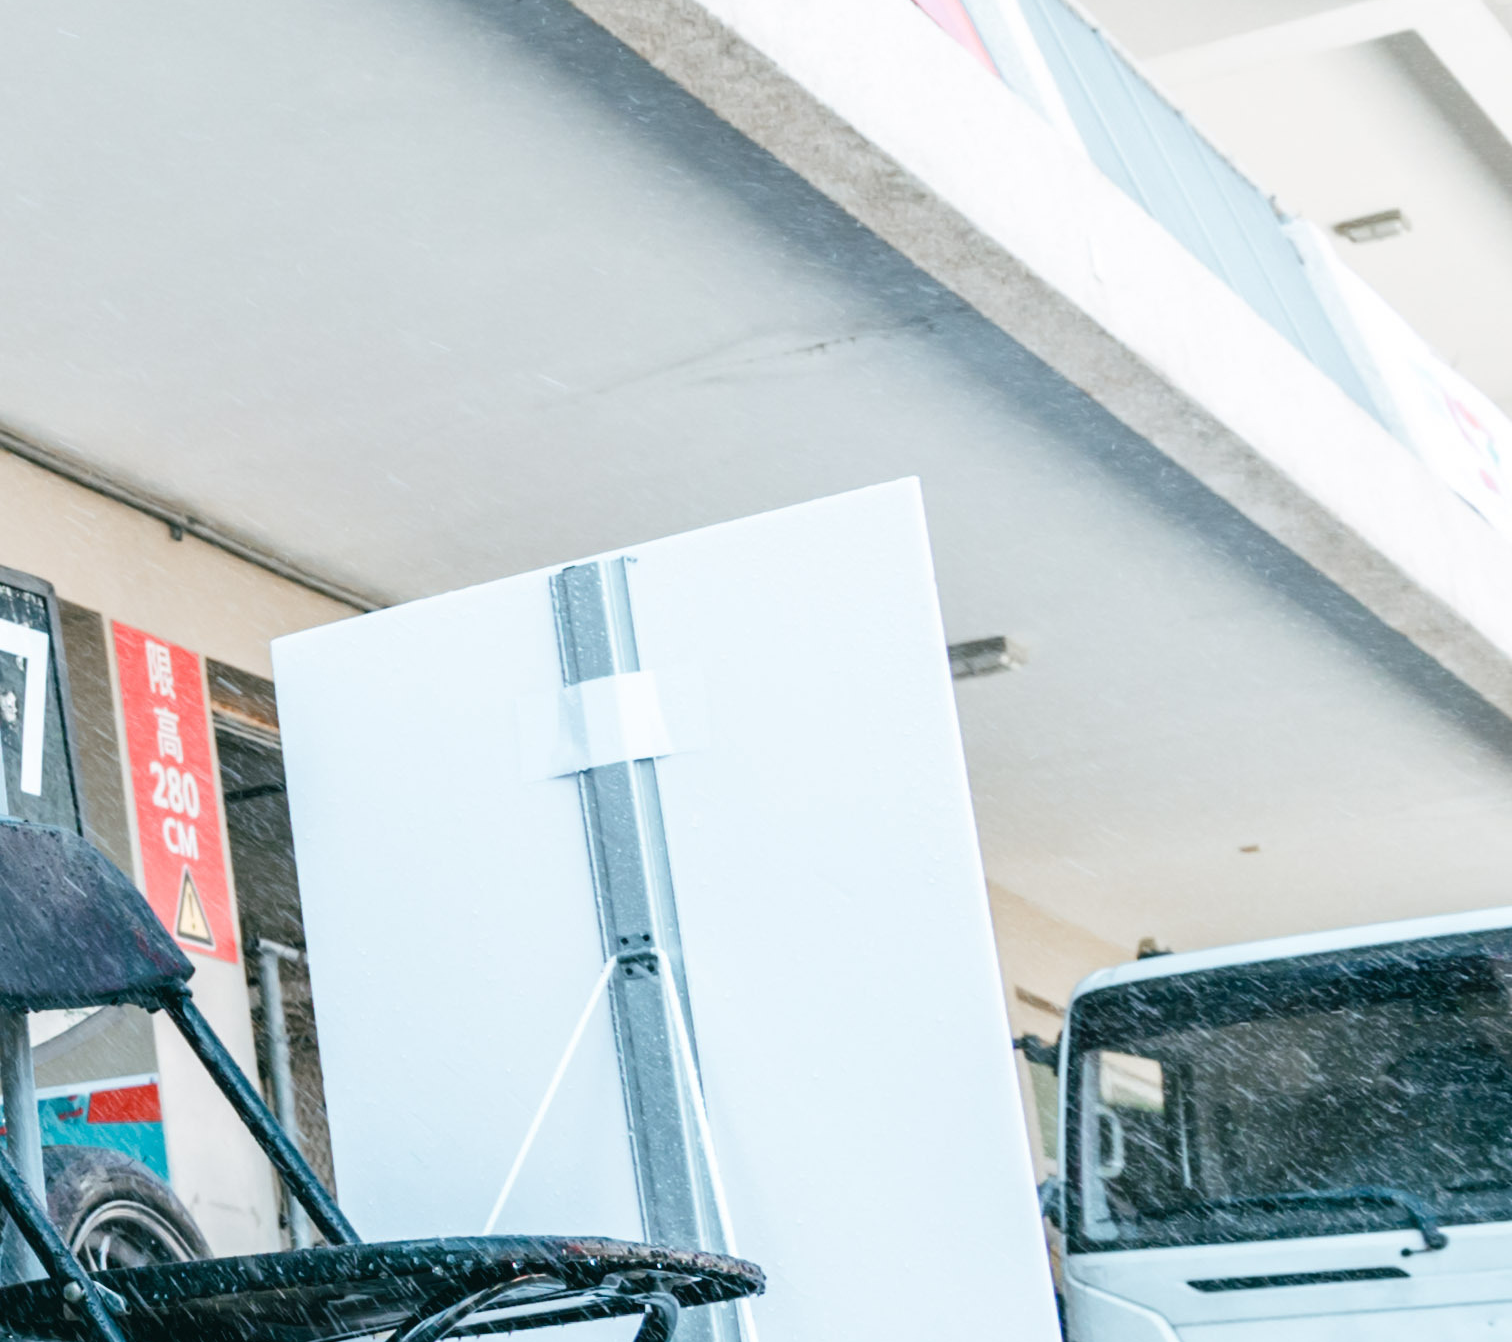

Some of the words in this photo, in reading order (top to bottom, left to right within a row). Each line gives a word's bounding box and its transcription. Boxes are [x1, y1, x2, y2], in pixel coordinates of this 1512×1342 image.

[144, 639, 184, 764] 限高
[149, 761, 200, 820] 280
[163, 817, 199, 861] CM
